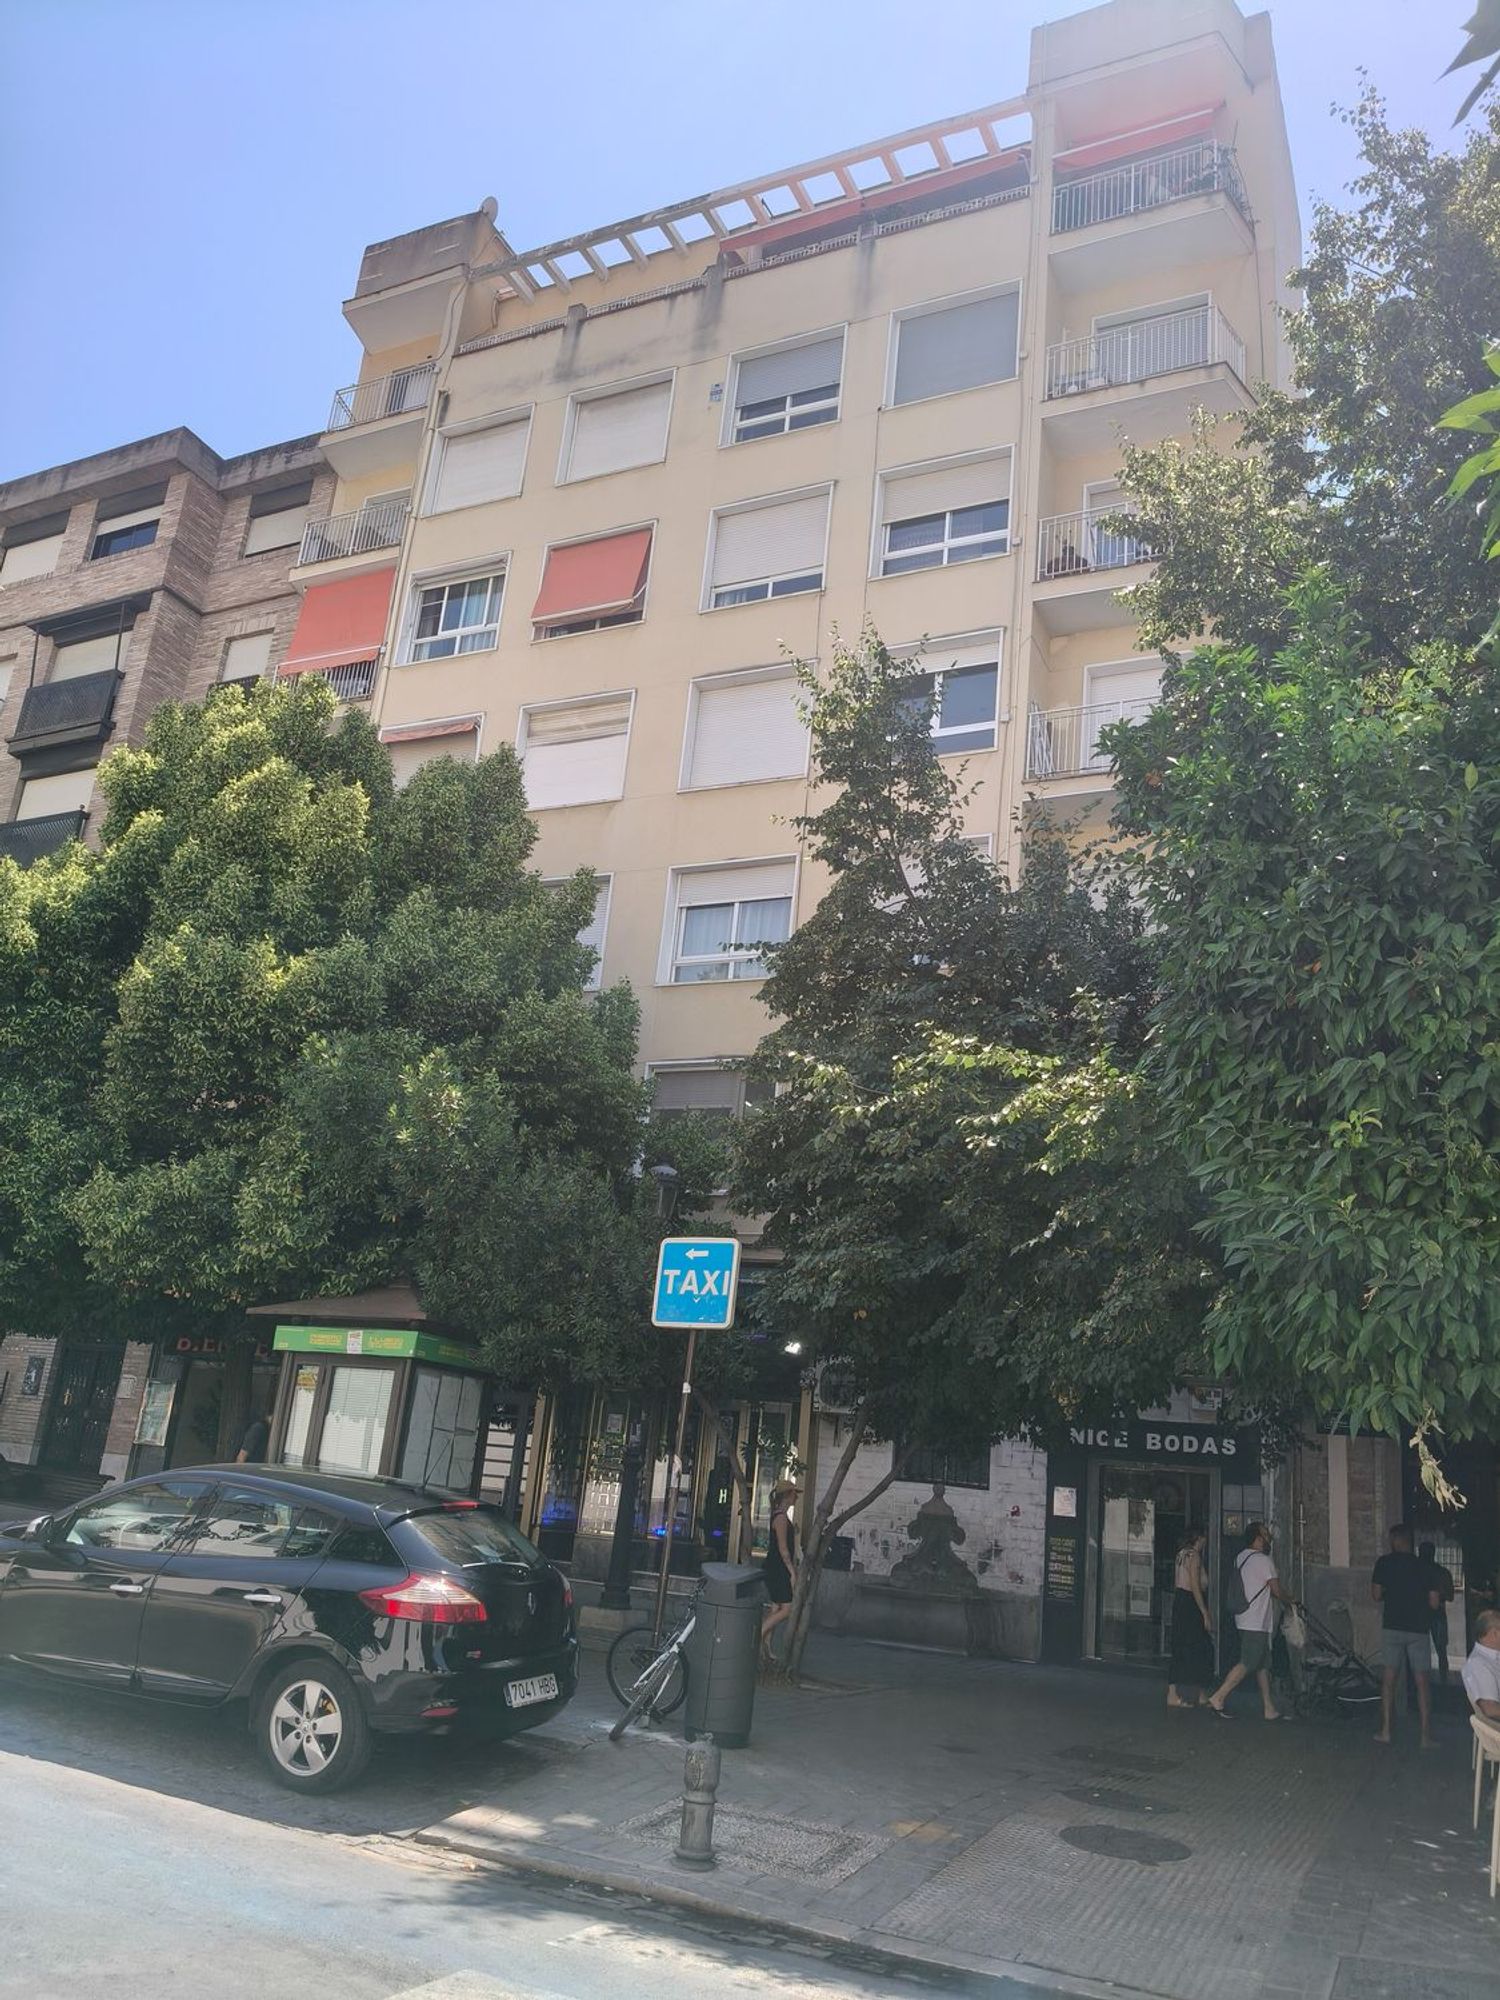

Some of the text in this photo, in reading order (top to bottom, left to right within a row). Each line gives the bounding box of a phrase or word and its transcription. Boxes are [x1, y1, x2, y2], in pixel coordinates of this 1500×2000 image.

[663, 1269, 730, 1296] TAXI
[1146, 1432, 1238, 1456] BODAS
[511, 1681, 537, 1701] 7041
